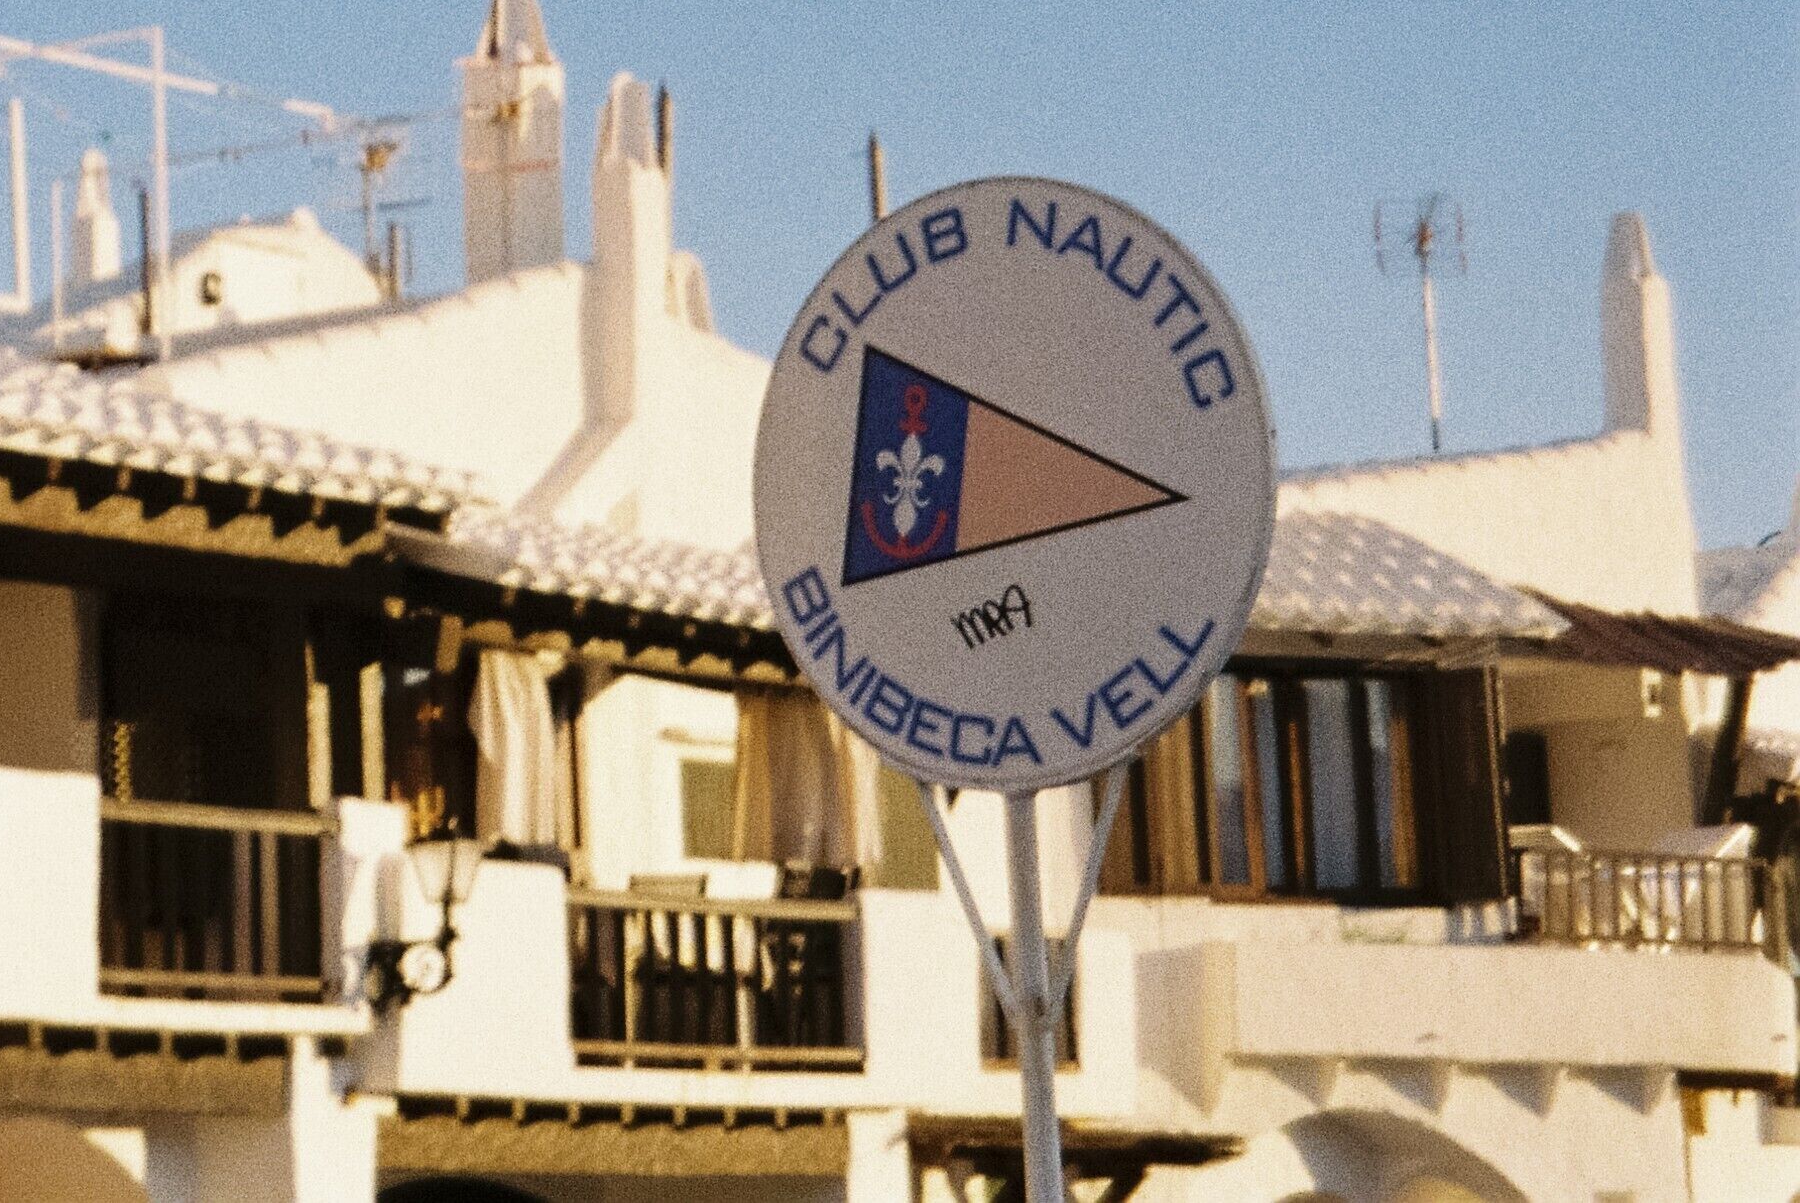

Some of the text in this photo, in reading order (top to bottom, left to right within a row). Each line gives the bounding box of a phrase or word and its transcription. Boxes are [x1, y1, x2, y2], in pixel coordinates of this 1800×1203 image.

[799, 197, 1237, 410] CLUB NAUTIC
[781, 565, 1216, 767] BINIBECA VELL
